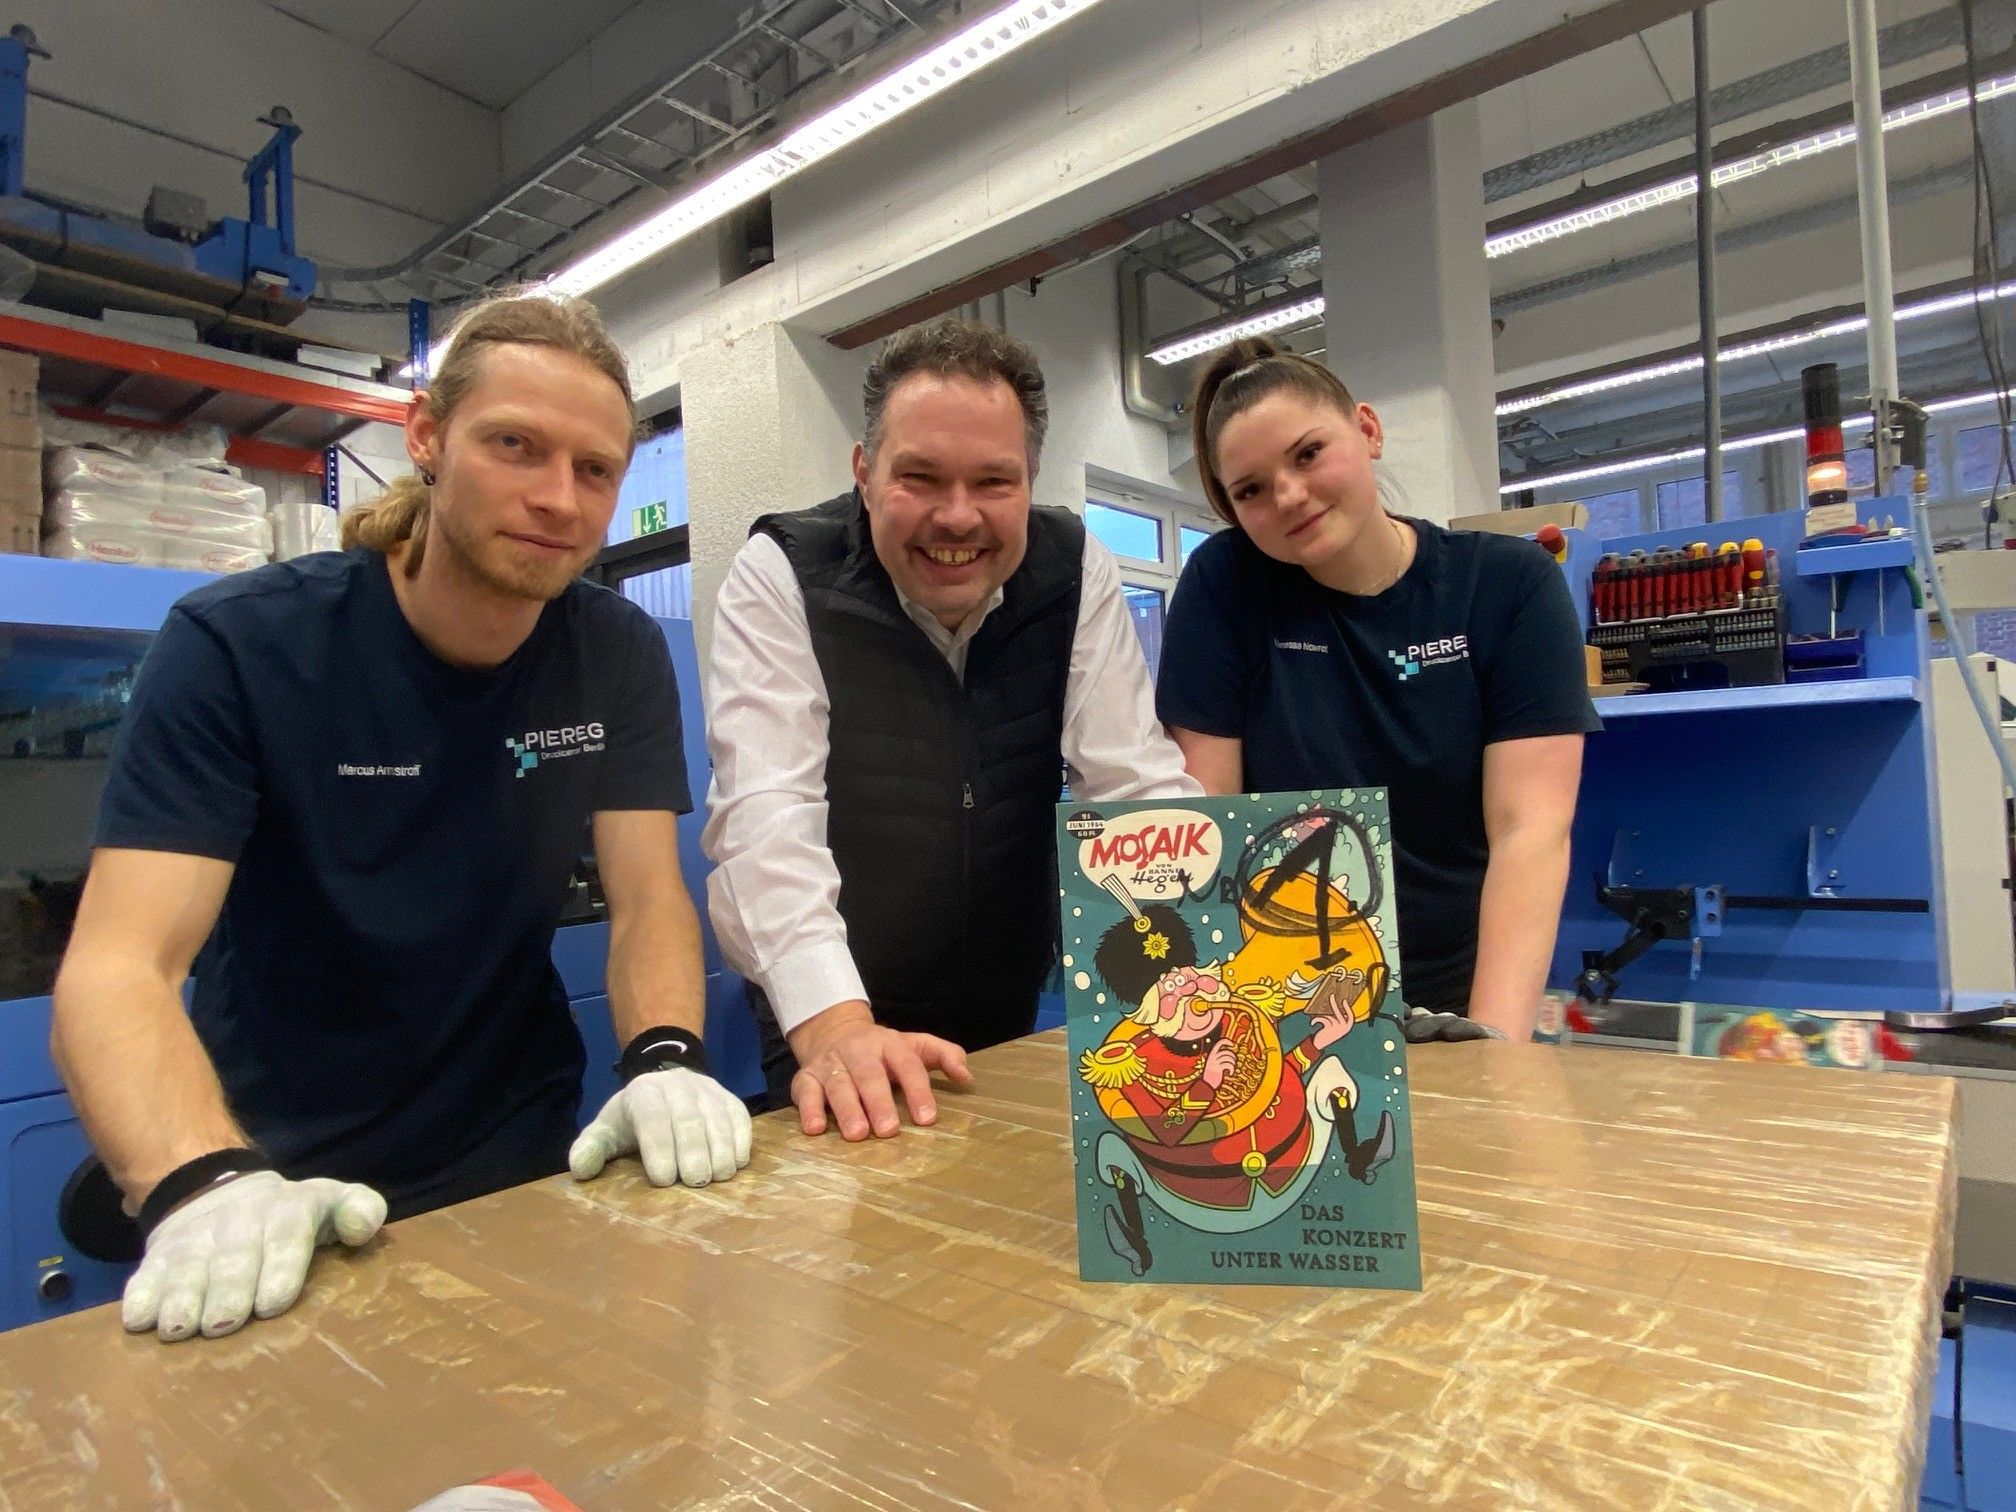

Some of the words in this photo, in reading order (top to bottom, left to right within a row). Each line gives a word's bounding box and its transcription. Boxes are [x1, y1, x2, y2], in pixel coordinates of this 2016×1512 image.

[1407, 635, 1468, 661] PIERE
[525, 722, 605, 750] PIEREG
[337, 764, 375, 776] Marcus
[1088, 822, 1214, 870] MOSAIK
[1301, 1204, 1344, 1222] DAS
[1302, 1228, 1407, 1250] KONZERT
[1211, 1251, 1283, 1269] UNTER
[1289, 1252, 1380, 1273] WASSER
